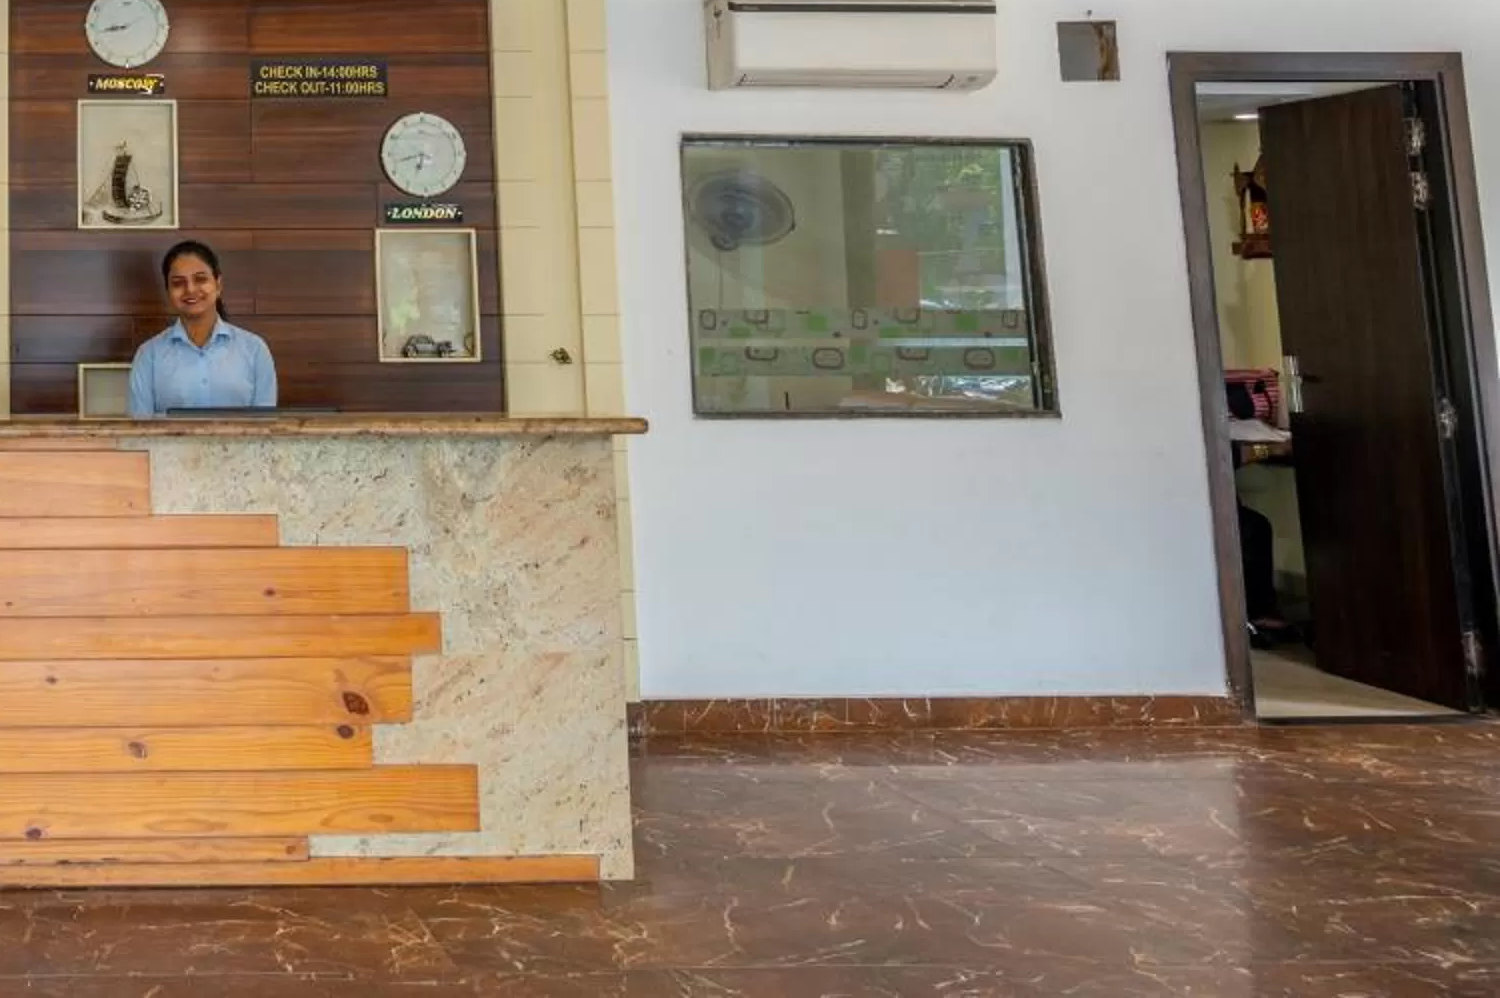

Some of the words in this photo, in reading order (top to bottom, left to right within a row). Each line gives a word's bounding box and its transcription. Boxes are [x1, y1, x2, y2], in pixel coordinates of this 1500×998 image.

[260, 65, 302, 79] CHECK
[255, 81, 298, 95] CHECK
[391, 207, 457, 219] LONDON
